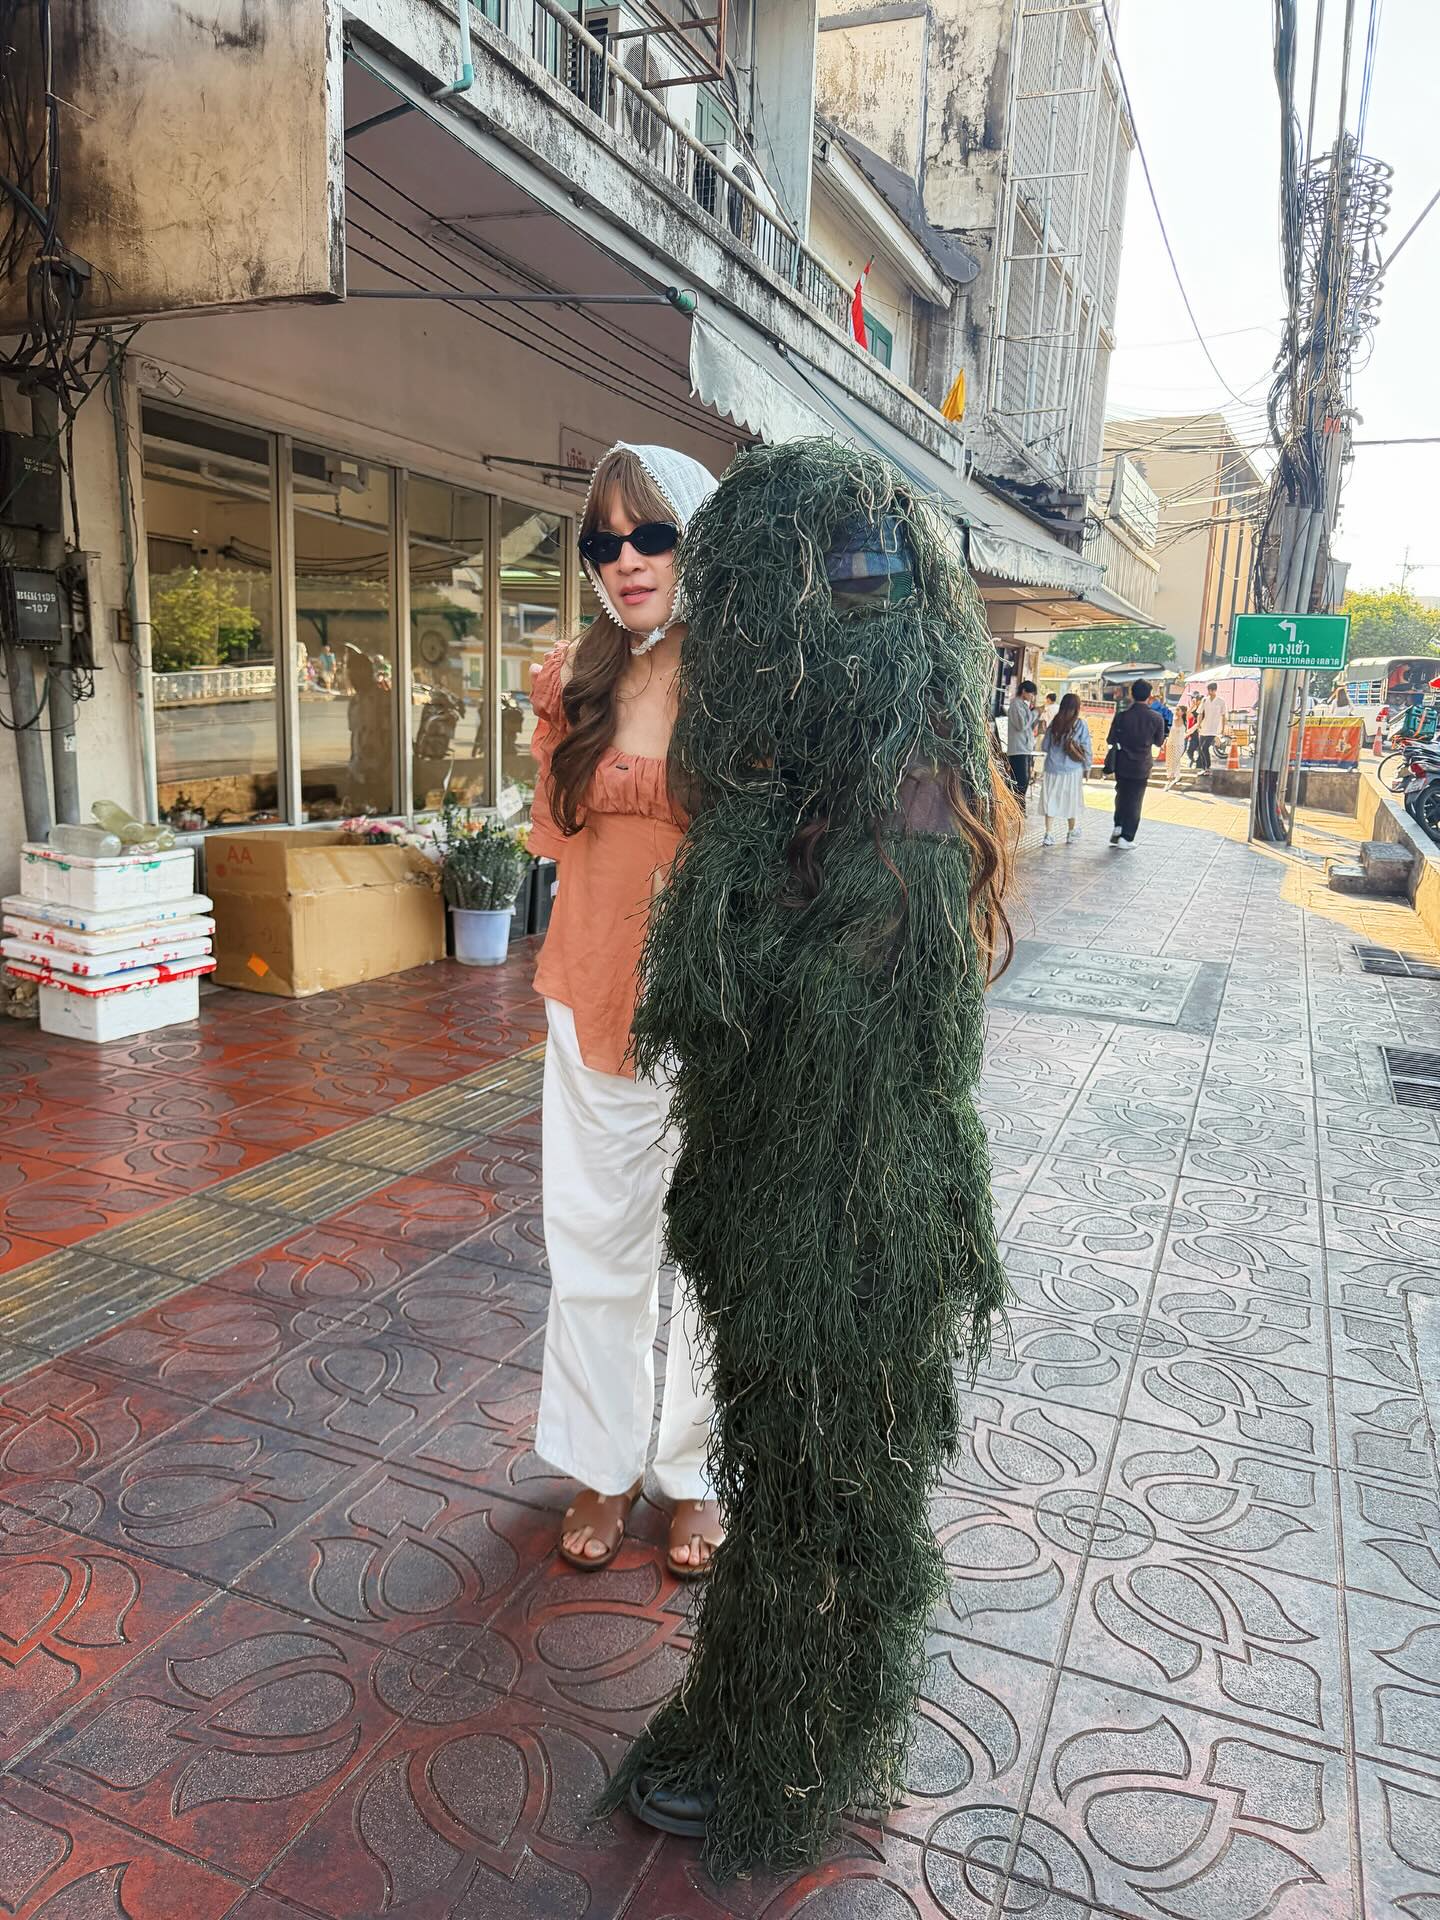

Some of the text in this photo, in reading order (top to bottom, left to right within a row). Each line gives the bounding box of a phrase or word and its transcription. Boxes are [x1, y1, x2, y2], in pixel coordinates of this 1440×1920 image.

[1268, 640, 1310, 655] ทางเข้า
[226, 845, 254, 865] AA
